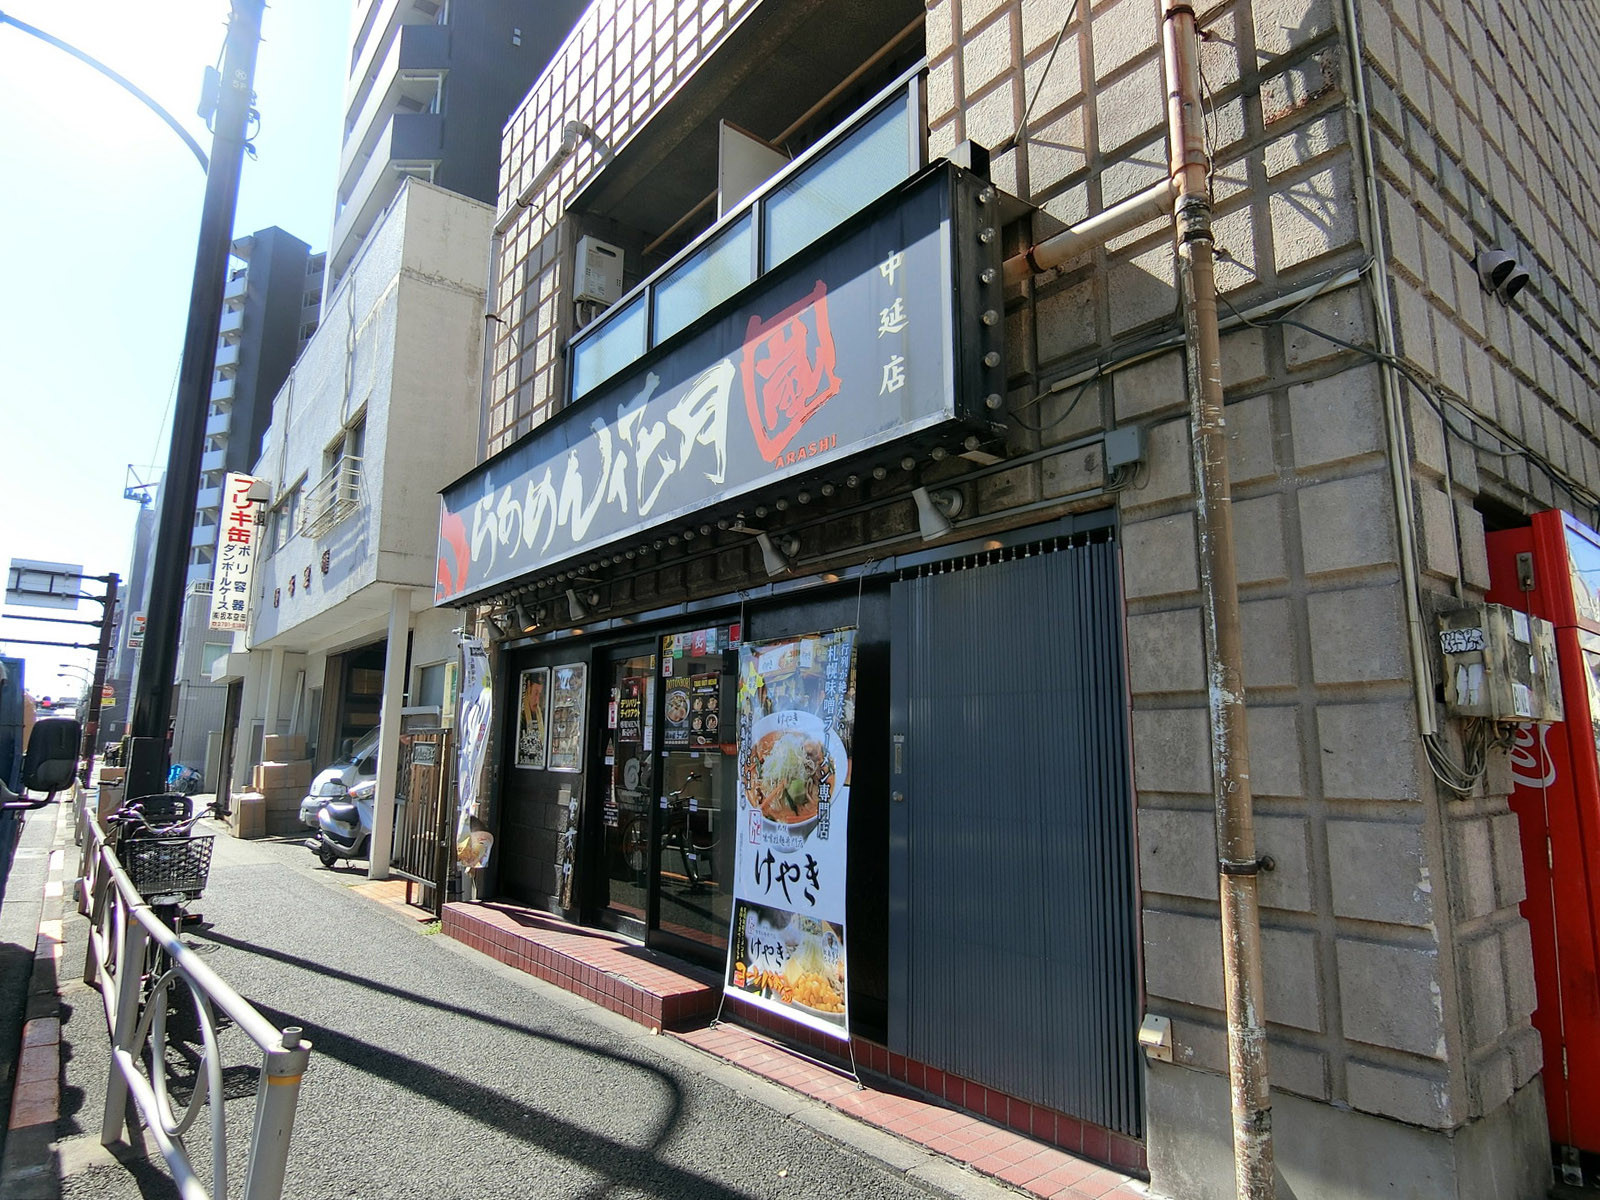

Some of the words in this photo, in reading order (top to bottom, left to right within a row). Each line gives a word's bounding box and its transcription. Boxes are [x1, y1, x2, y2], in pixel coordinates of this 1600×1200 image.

[878, 250, 909, 398] 中延店
[774, 433, 838, 470] ARASHI
[755, 847, 820, 907] けやき
[750, 937, 784, 967] けやき
